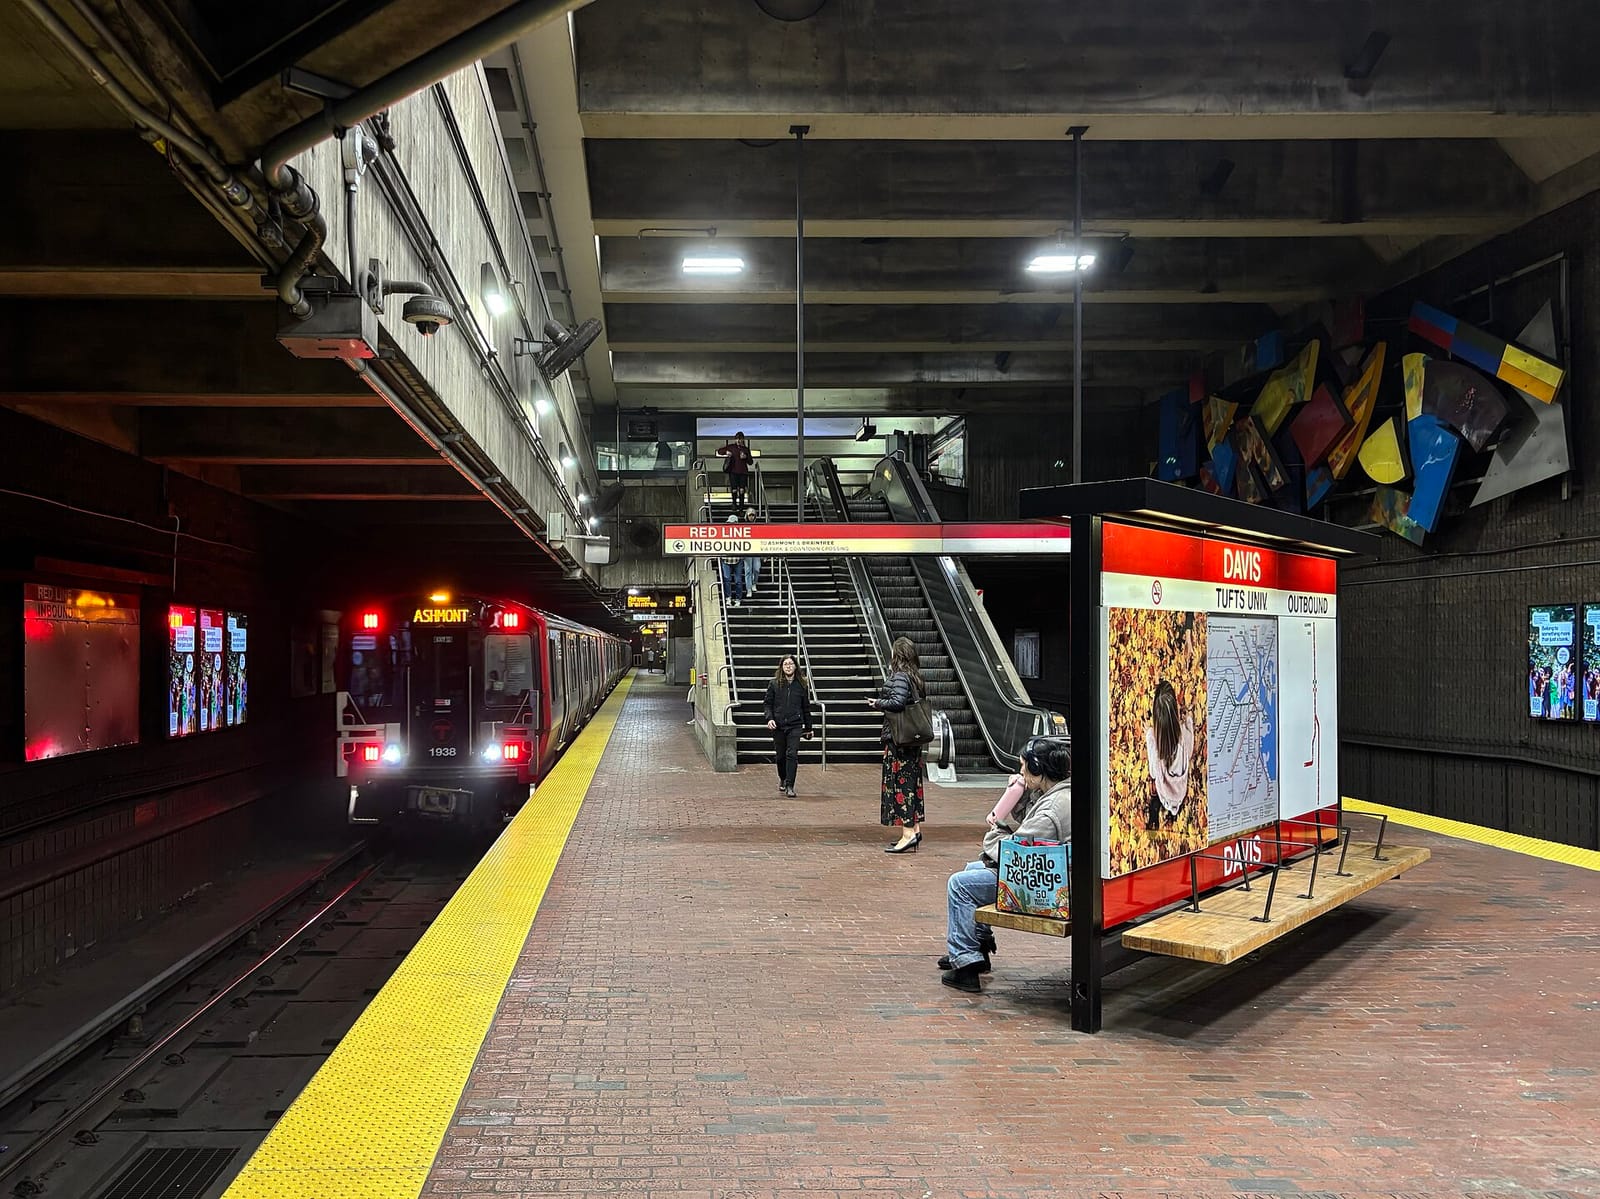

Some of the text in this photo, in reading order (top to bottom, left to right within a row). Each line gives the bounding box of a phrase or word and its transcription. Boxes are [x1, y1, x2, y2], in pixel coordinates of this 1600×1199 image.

[689, 527, 751, 538] RED LINE
[689, 541, 752, 552] INBOUND
[1223, 547, 1262, 582] DAVIS
[38, 586, 53, 600] RED
[1215, 587, 1268, 611] TUFTS UNIV.
[38, 602, 73, 619] INBOUND
[1287, 594, 1329, 614] OUTBOUND
[413, 609, 469, 622] ASHMONT
[429, 747, 457, 757] 1938
[1012, 850, 1055, 872] Buffalo
[1223, 834, 1262, 876] DAVIS
[1004, 864, 1062, 891] Exchange
[1035, 890, 1047, 899] 50
